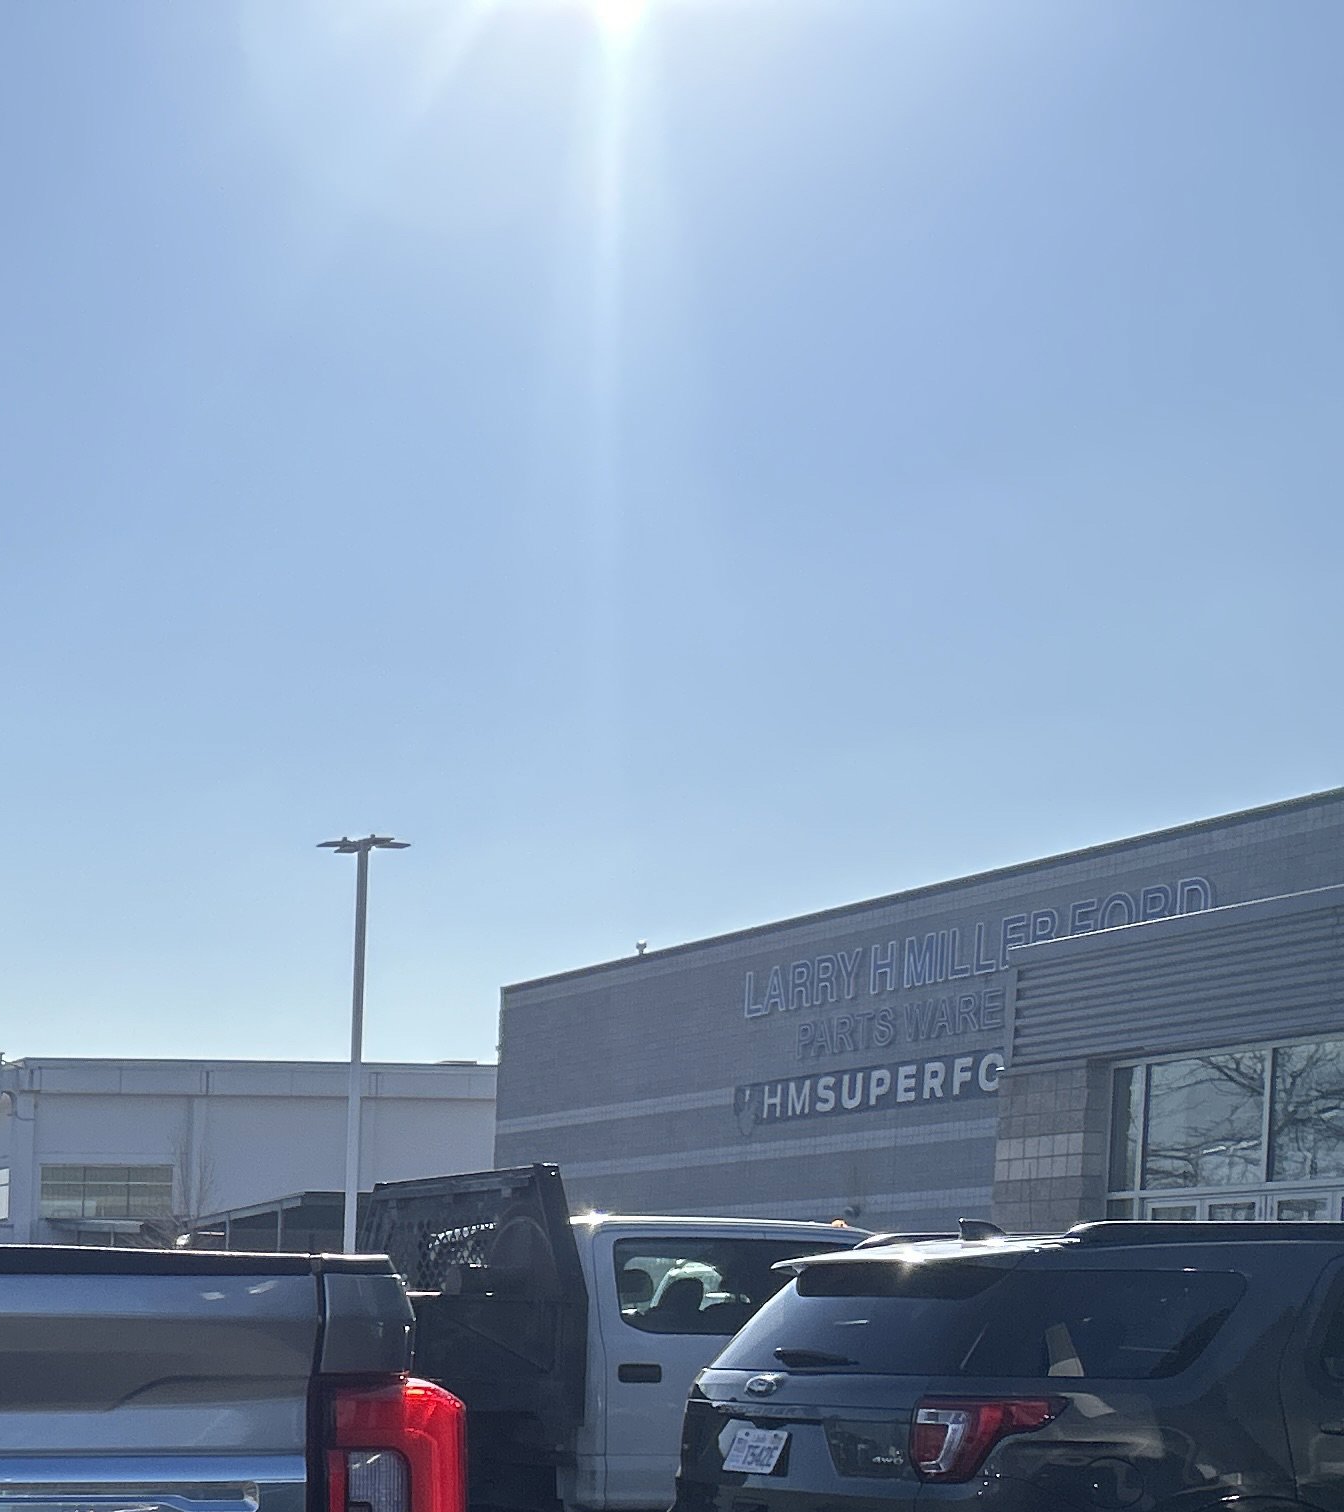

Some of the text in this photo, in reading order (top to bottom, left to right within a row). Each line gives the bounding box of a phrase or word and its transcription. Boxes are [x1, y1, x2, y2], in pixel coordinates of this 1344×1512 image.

[744, 948, 862, 1018] LARRY
[870, 941, 897, 994] H
[796, 988, 1006, 1060] PARTS WARE
